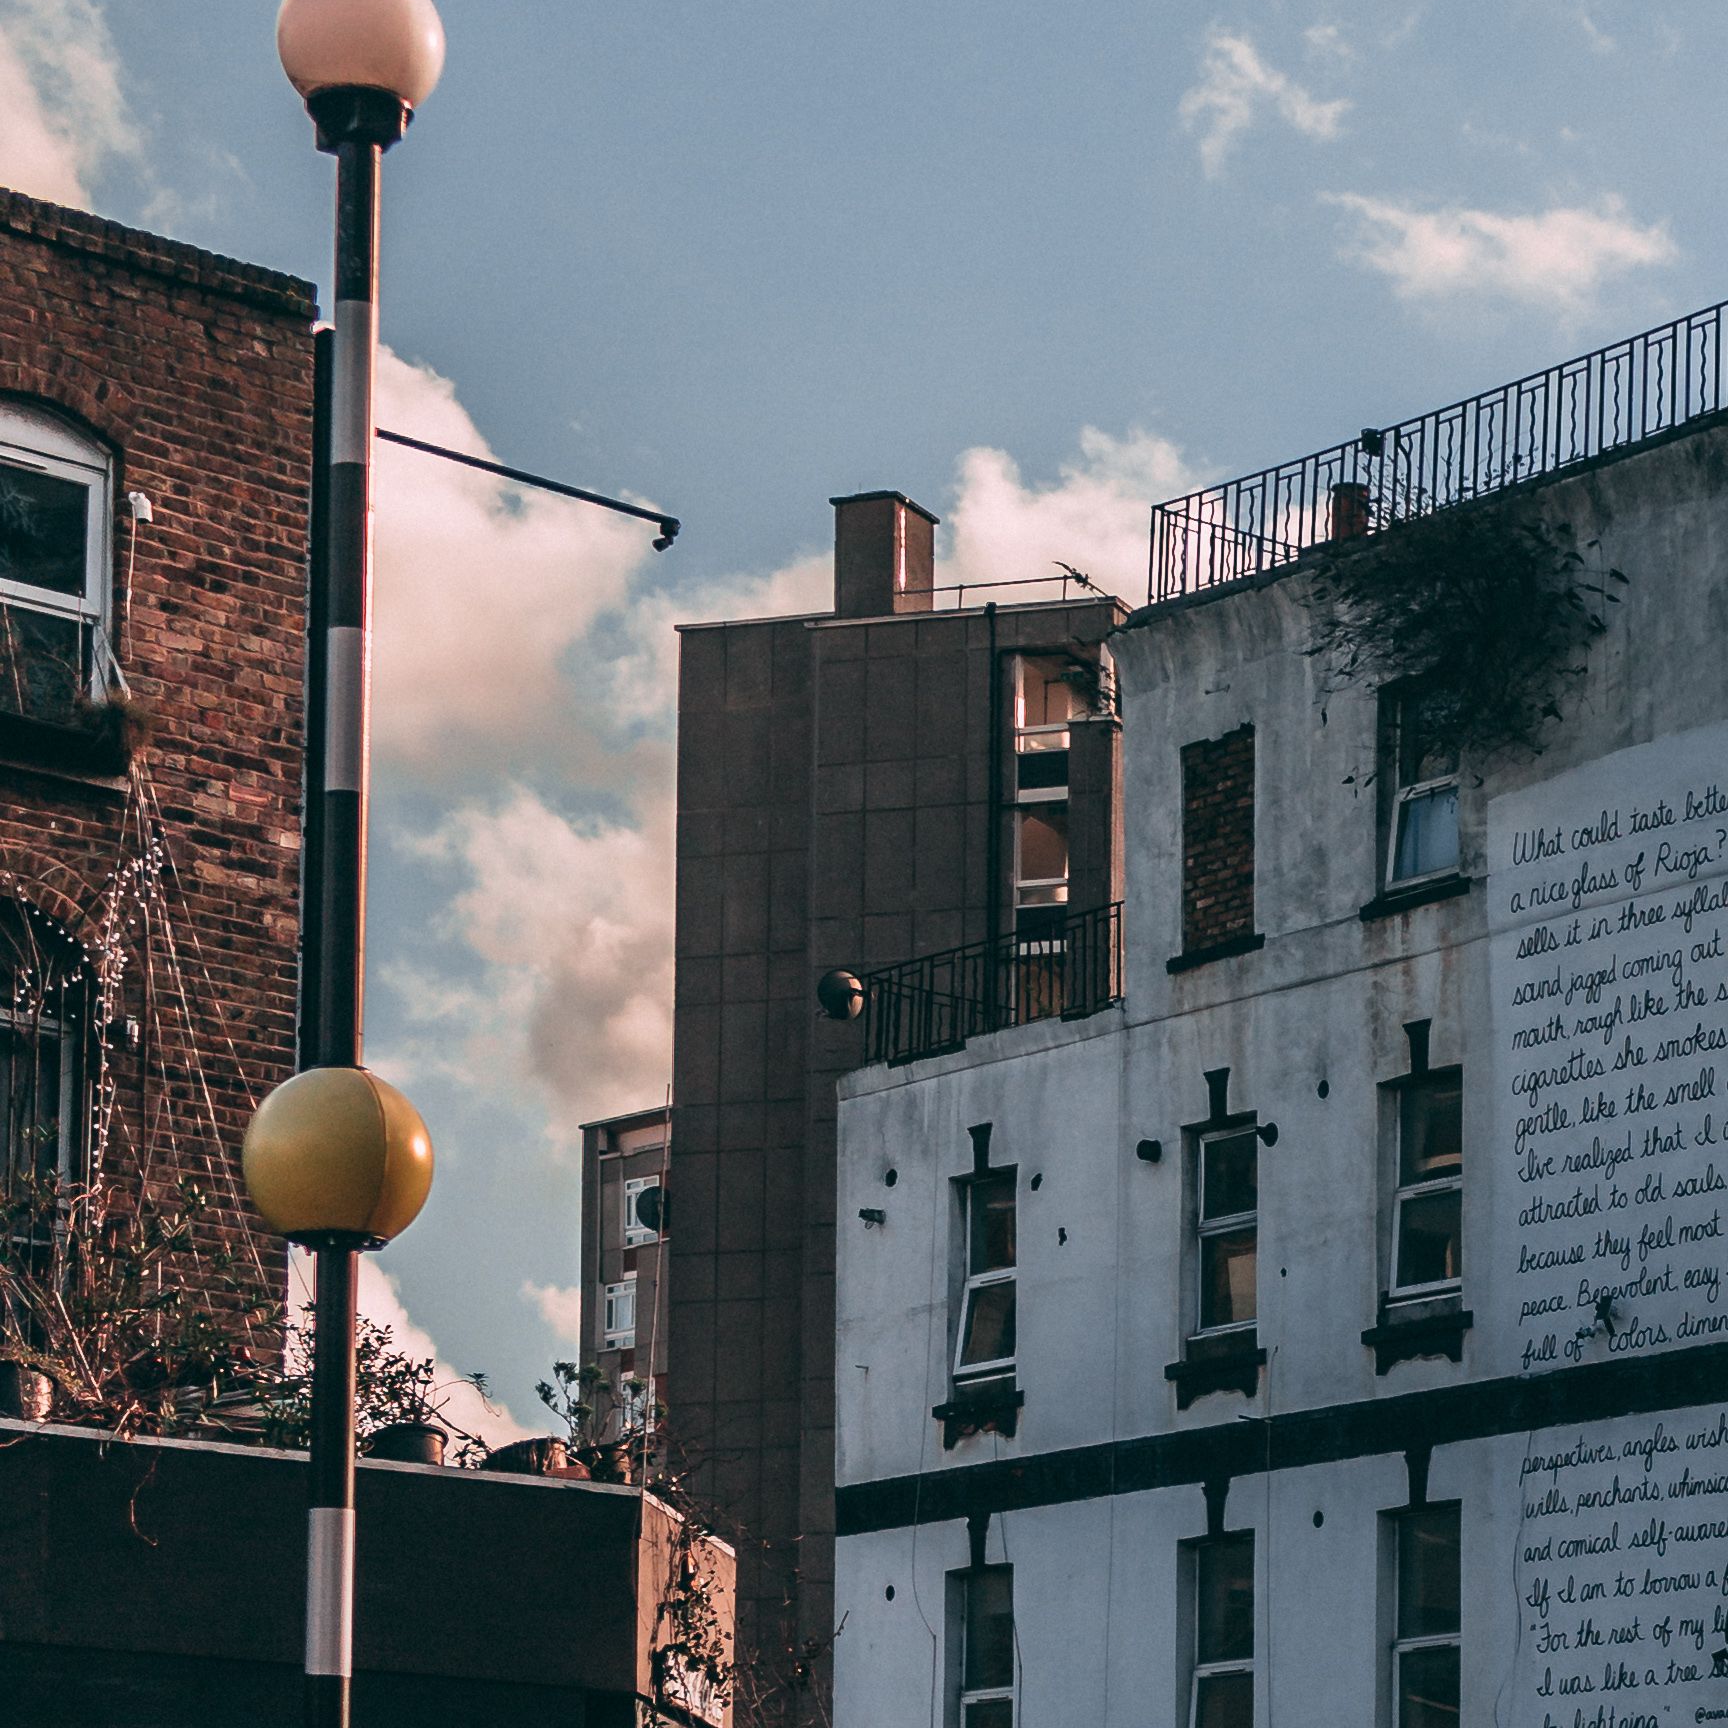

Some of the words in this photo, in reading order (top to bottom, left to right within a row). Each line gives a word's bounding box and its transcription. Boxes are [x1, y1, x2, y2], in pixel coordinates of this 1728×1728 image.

[1513, 827, 1565, 865] What
[1572, 810, 1621, 849] could
[1629, 800, 1677, 835] taste
[1511, 892, 1525, 913] a
[1529, 881, 1568, 906] nice
[1572, 862, 1619, 909] glass
[1625, 852, 1645, 891] of
[1516, 927, 1559, 960] sells
[1564, 919, 1582, 947] it
[1588, 918, 1612, 941] in
[1617, 902, 1666, 933] three
[1512, 965, 1564, 1006] sound
[1565, 954, 1617, 1005] jagged
[1622, 949, 1683, 986] coming
[1691, 929, 1724, 963] out
[1573, 996, 1623, 1045] rough
[1627, 991, 1670, 1023] like
[1674, 980, 1708, 1011] the
[1512, 1047, 1606, 1107] cigarettes
[1611, 1035, 1647, 1071] she
[1580, 1091, 1617, 1124] like
[1625, 1083, 1658, 1115] the
[1663, 1067, 1715, 1105] smell
[1561, 1130, 1634, 1179] realized
[1640, 1122, 1686, 1157] that
[1695, 1114, 1717, 1145] I
[1519, 1184, 1601, 1226] attracted
[1608, 1184, 1627, 1210] to
[1635, 1173, 1666, 1204] old
[1517, 1245, 1585, 1273] because
[1593, 1230, 1631, 1270] they
[1638, 1215, 1675, 1261] feel
[1679, 1209, 1724, 1244] most
[1521, 1335, 1557, 1369] full
[1565, 1337, 1584, 1362] of
[1524, 1537, 1552, 1562] and
[1558, 1522, 1620, 1558] comical
[1526, 1577, 1551, 1618] If
[1558, 1575, 1576, 1603] I
[1581, 1584, 1607, 1601] am
[1613, 1572, 1636, 1597] to
[1640, 1569, 1701, 1594] borrow
[1705, 1573, 1717, 1587] a
[1575, 1618, 1603, 1649] the
[1608, 1617, 1645, 1645] rest
[1653, 1616, 1672, 1647] of
[1679, 1619, 1704, 1650] my
[1537, 1667, 1554, 1697] I
[1559, 1677, 1595, 1694] was
[1600, 1662, 1640, 1692] like
[1644, 1669, 1659, 1686] a
[1664, 1659, 1703, 1685] tree
